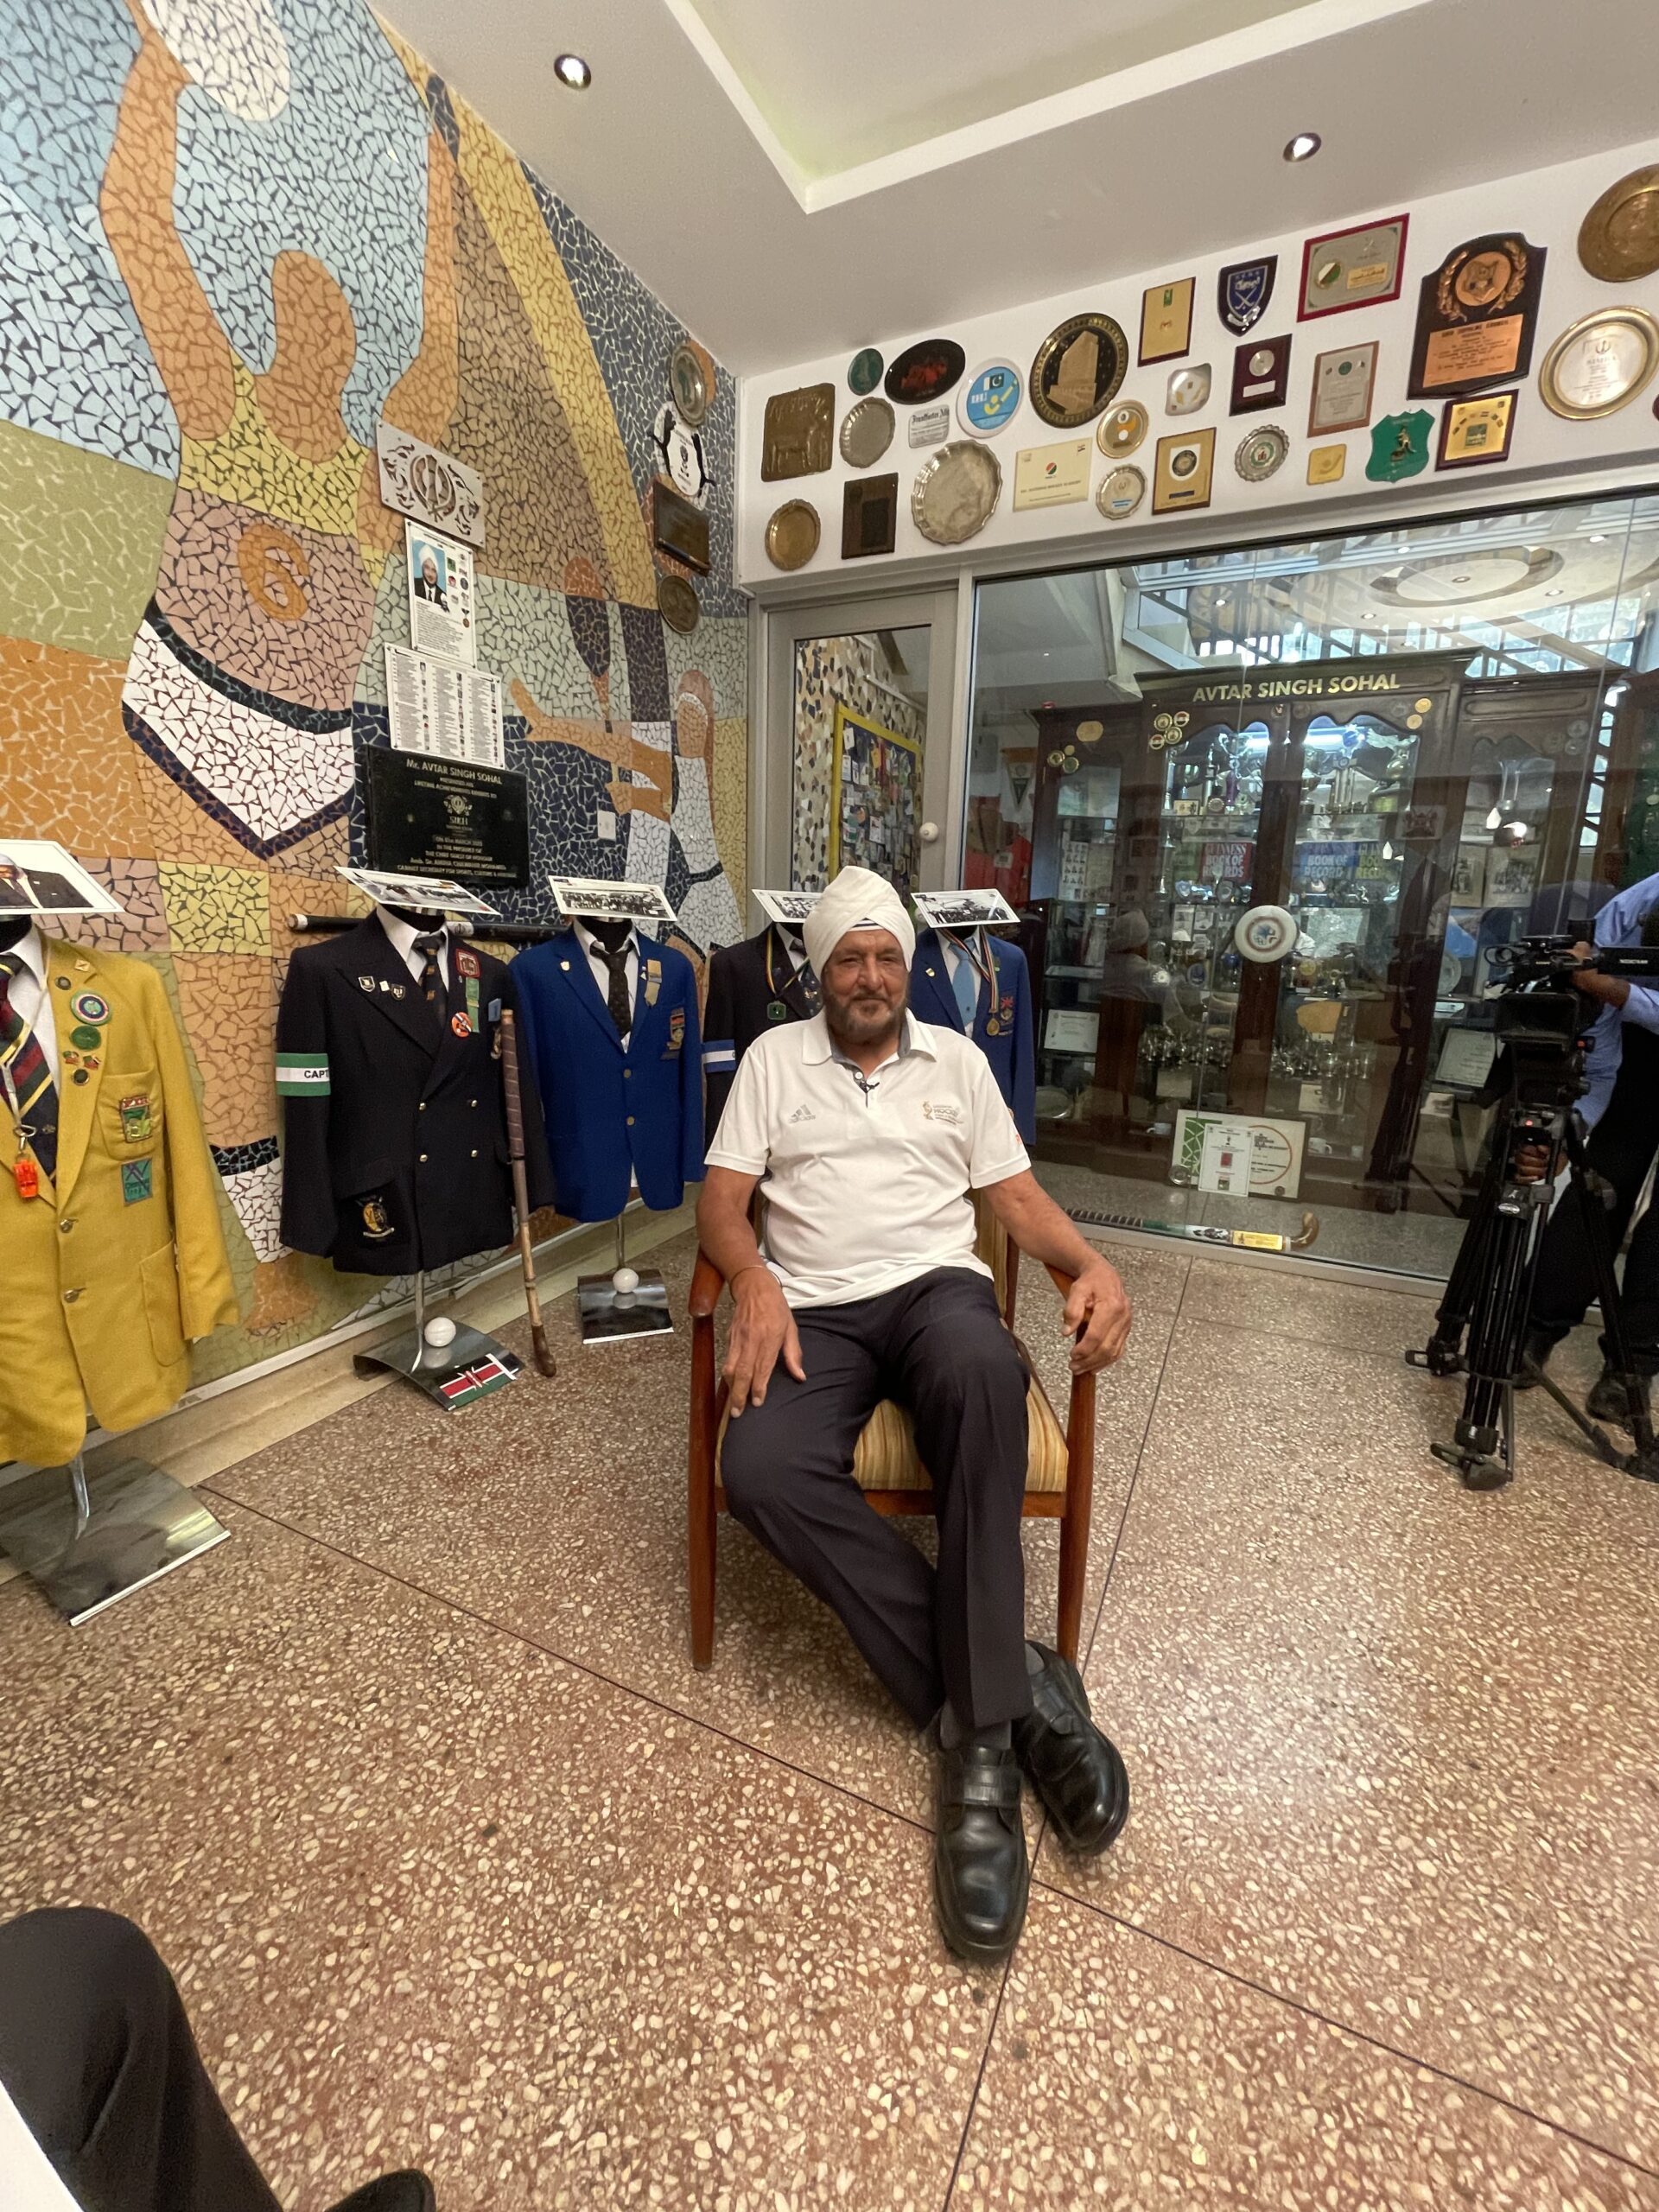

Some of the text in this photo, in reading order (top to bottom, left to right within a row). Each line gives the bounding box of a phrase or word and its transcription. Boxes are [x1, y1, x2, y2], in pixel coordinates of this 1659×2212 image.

[1192, 673, 1401, 702] AVTAR SINGH SOHAL
[406, 759, 502, 785] Mr. AVTAR SINGH SOHAL
[1231, 855, 1244, 866] OF
[1307, 855, 1336, 866] BOOK
